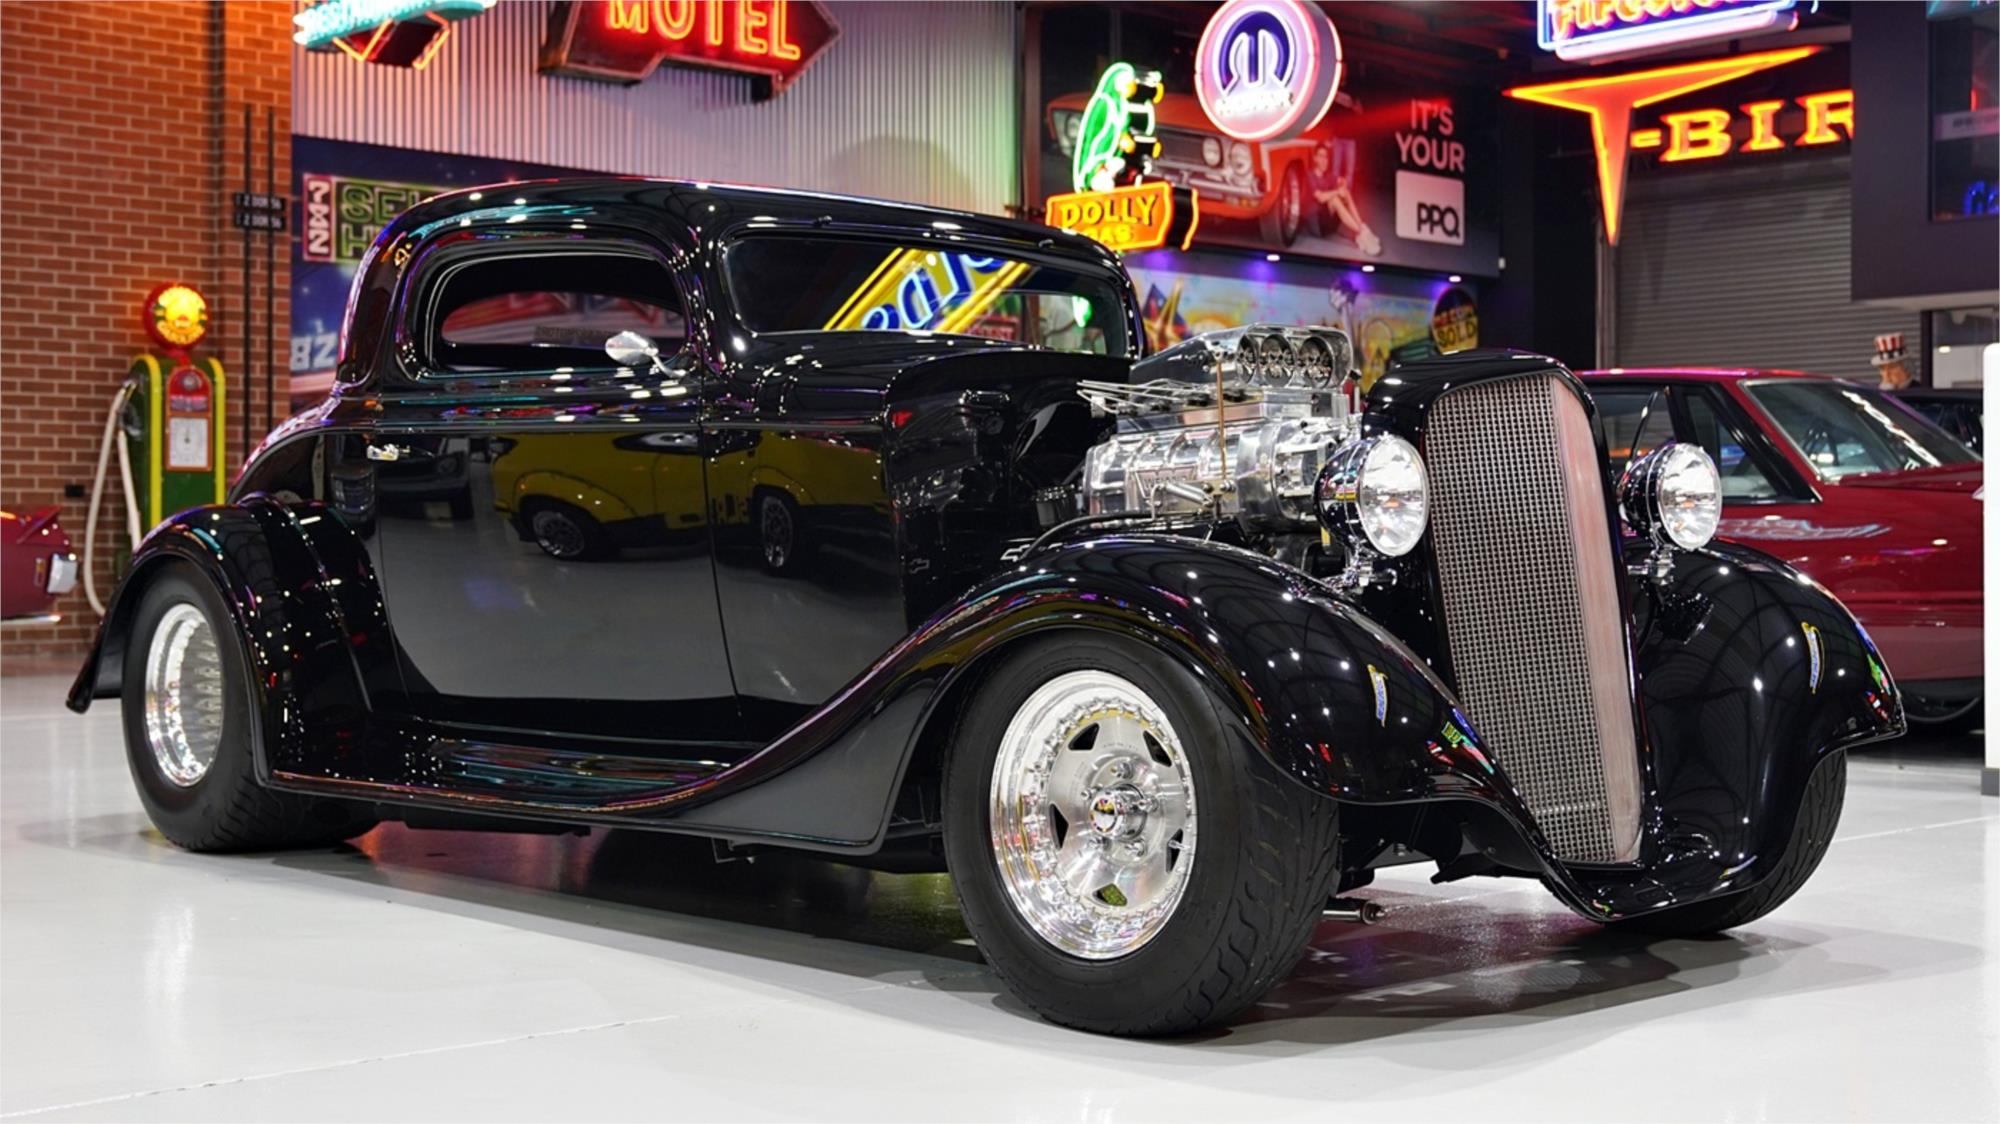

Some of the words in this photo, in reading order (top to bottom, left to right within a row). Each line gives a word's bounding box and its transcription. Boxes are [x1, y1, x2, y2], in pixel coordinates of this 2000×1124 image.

[1411, 99, 1454, 136] IT'S
[1395, 132, 1465, 173] YOUR
[1417, 202, 1460, 239] PPQ
[1437, 320, 1476, 348] SOLD
